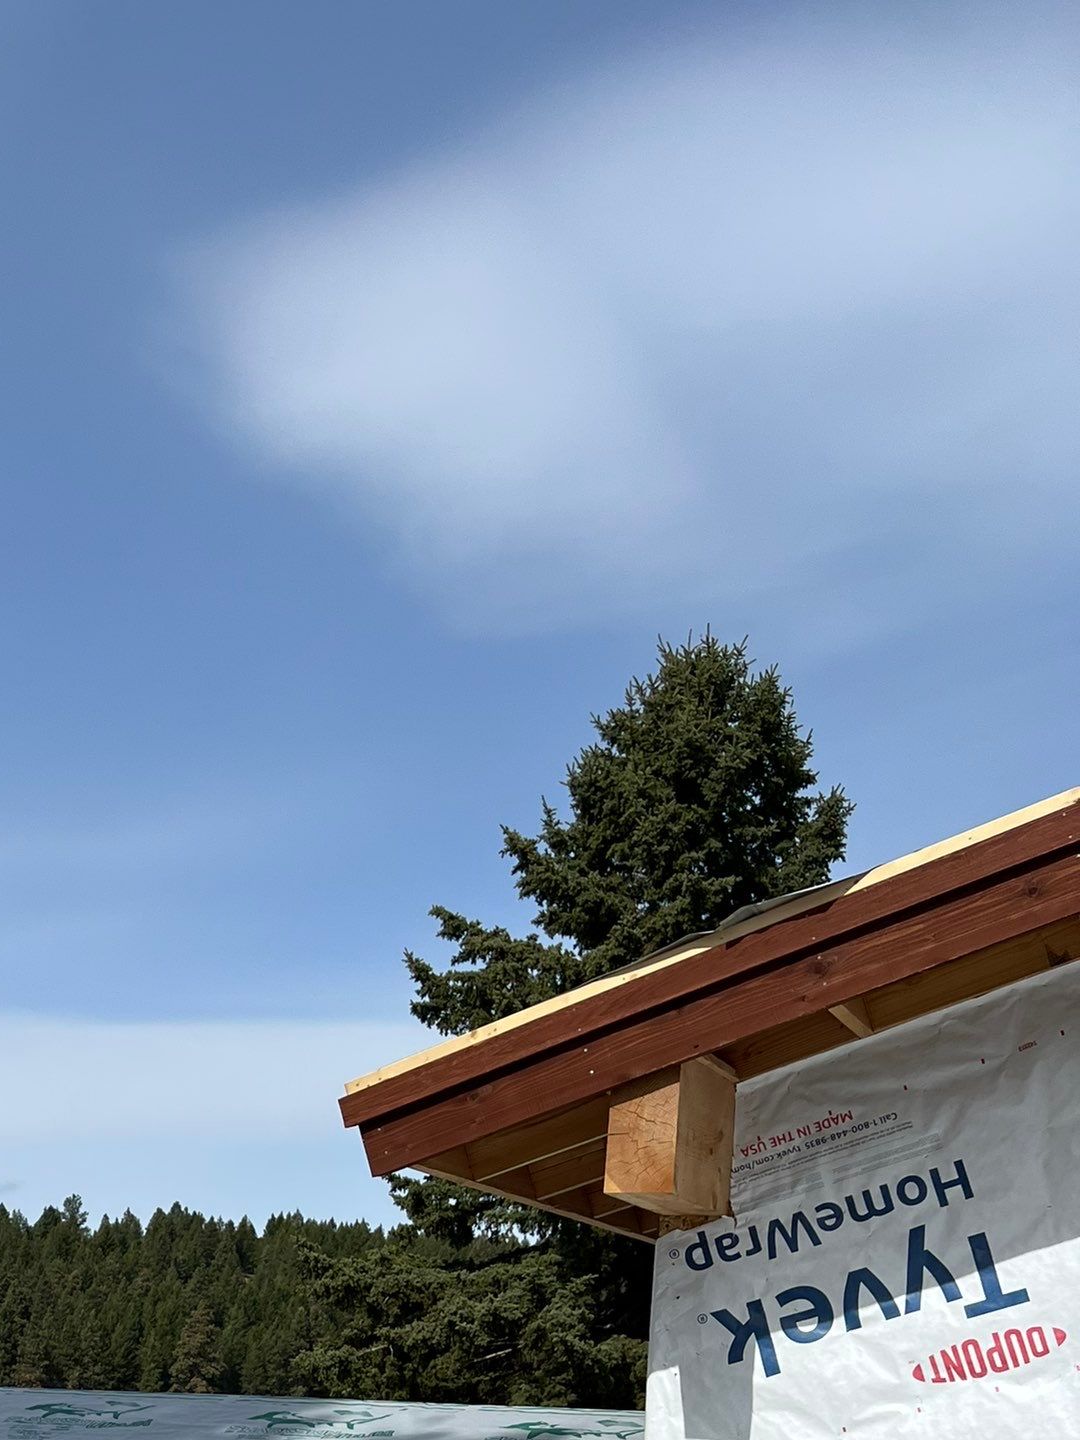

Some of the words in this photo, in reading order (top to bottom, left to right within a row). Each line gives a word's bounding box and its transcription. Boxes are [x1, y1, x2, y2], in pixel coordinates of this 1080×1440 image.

[815, 1110, 853, 1133] MADE
[878, 1112, 898, 1123] Call
[770, 1132, 795, 1148] THE
[797, 1126, 813, 1139] IN
[740, 1138, 768, 1158] USA
[930, 1326, 1051, 1384] DUPONT
